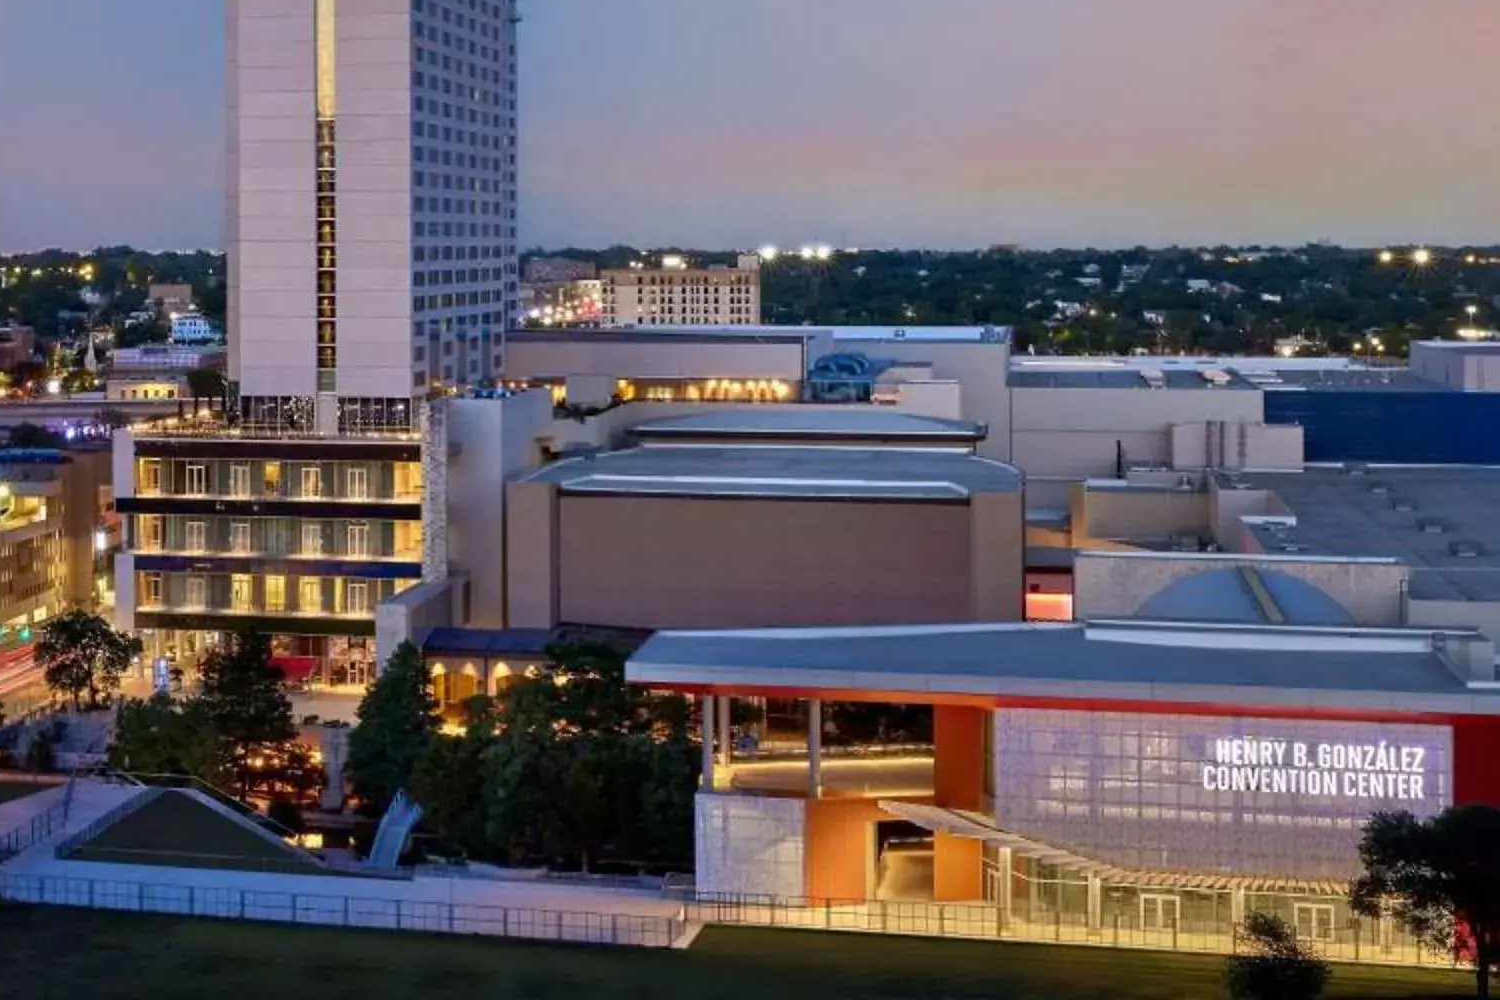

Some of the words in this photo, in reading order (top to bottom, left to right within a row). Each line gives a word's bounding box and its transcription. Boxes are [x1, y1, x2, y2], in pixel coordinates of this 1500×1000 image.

[1215, 738, 1286, 766] HENRY
[1293, 743, 1313, 768] B.
[1317, 740, 1425, 773] GONZÁLEZ
[1202, 765, 1337, 796] CONVENTION
[1343, 772, 1425, 800] CENTER
